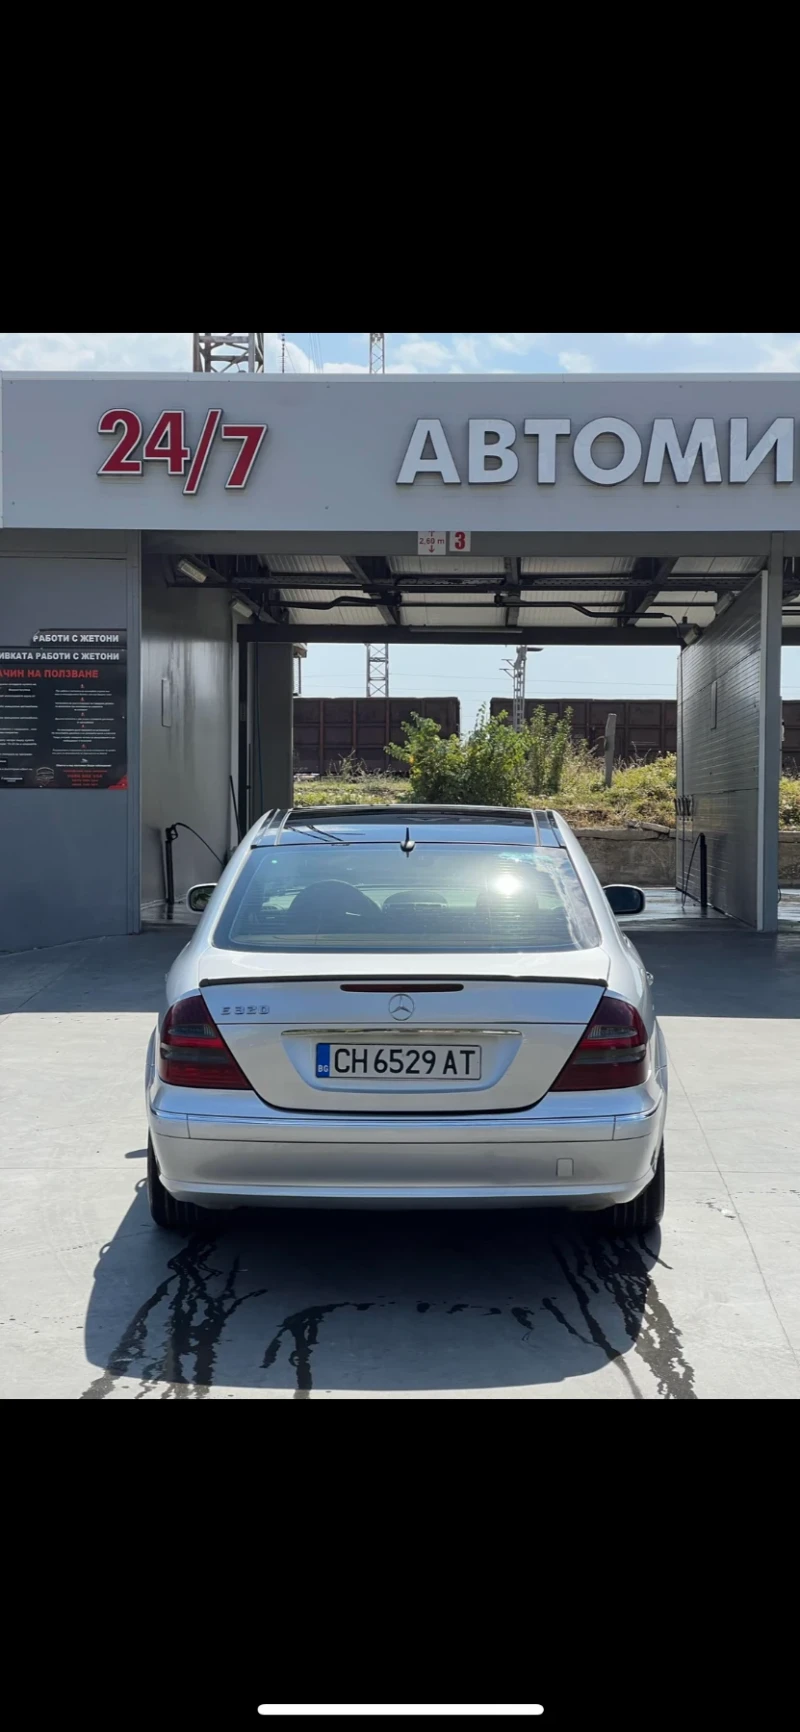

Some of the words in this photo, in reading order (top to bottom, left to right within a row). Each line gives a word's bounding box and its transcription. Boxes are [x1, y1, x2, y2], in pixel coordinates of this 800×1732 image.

[97, 408, 268, 495] 24/7
[395, 416, 795, 486] АВТОМИ
[454, 531, 466, 550] 3
[32, 634, 69, 643] РАБОТИ
[71, 634, 78, 643] С
[80, 634, 120, 643] ЖЕТОНИ
[35, 652, 71, 660] РАБОТИ
[72, 652, 79, 661] С
[81, 652, 120, 661] ЖЕТОНИ
[27, 669, 42, 678] НА
[44, 669, 99, 678] ПОЛЗВАНЕ
[317, 1064, 329, 1073] BG
[334, 1048, 368, 1073] CH
[373, 1049, 436, 1075] 6529
[442, 1050, 476, 1075] AT
